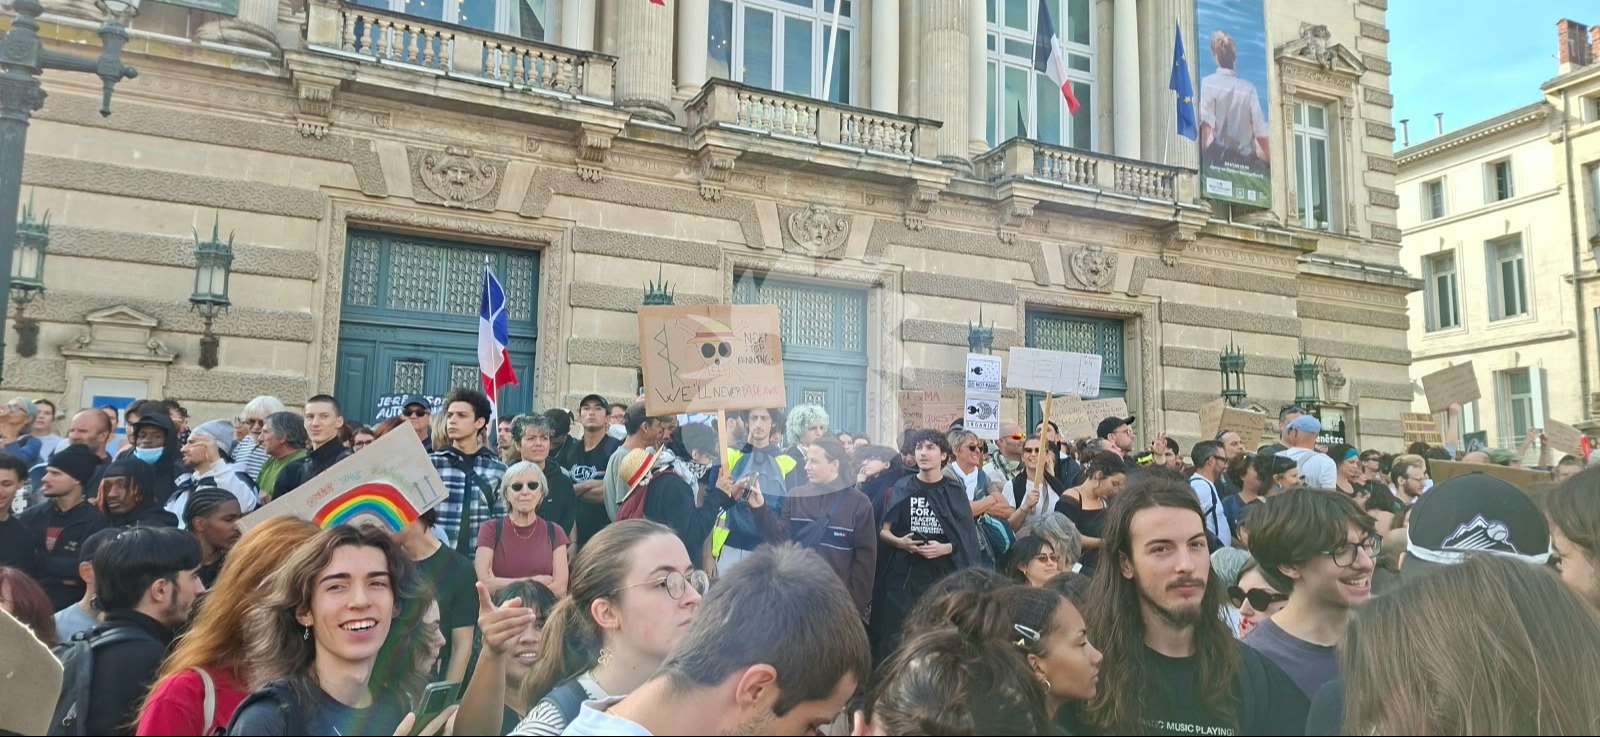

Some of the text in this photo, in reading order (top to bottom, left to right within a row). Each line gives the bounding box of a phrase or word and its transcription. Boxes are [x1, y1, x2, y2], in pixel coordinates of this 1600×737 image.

[712, 385, 740, 399] NEVER
[1315, 432, 1344, 444] enêtre
[910, 496, 930, 508] PEA
[910, 507, 929, 517] FOR
[1166, 721, 1194, 733] MUSIC
